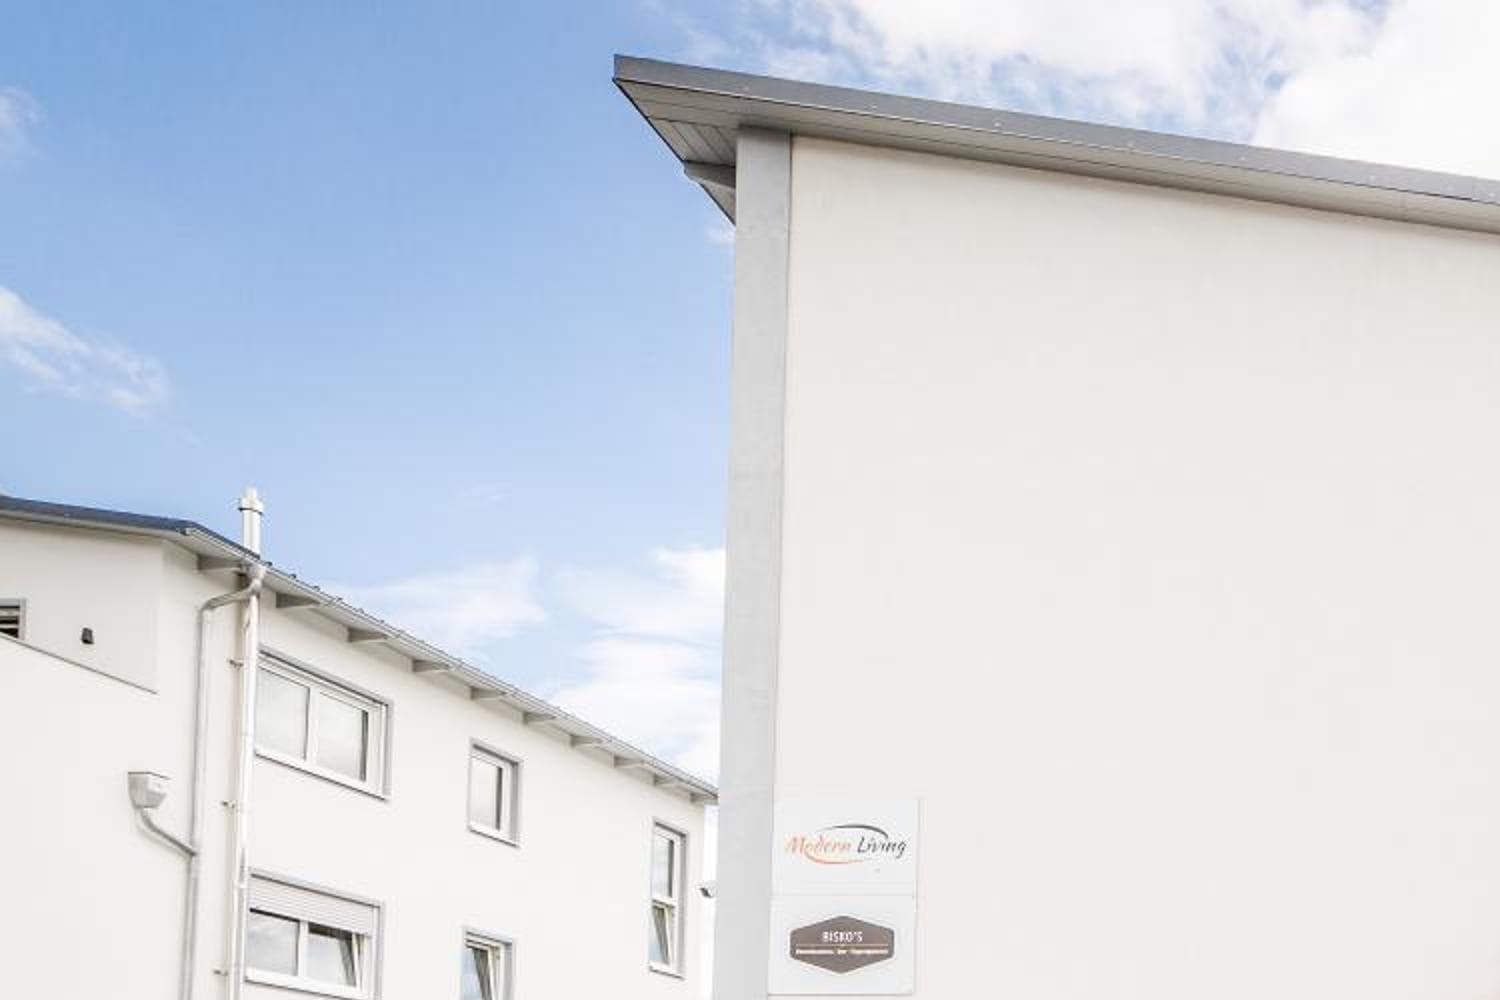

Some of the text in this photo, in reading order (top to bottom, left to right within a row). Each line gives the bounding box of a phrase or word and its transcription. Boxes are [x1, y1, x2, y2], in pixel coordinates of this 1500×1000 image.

[787, 835, 907, 859] Modern Living
[822, 931, 863, 942] BISKO'S
